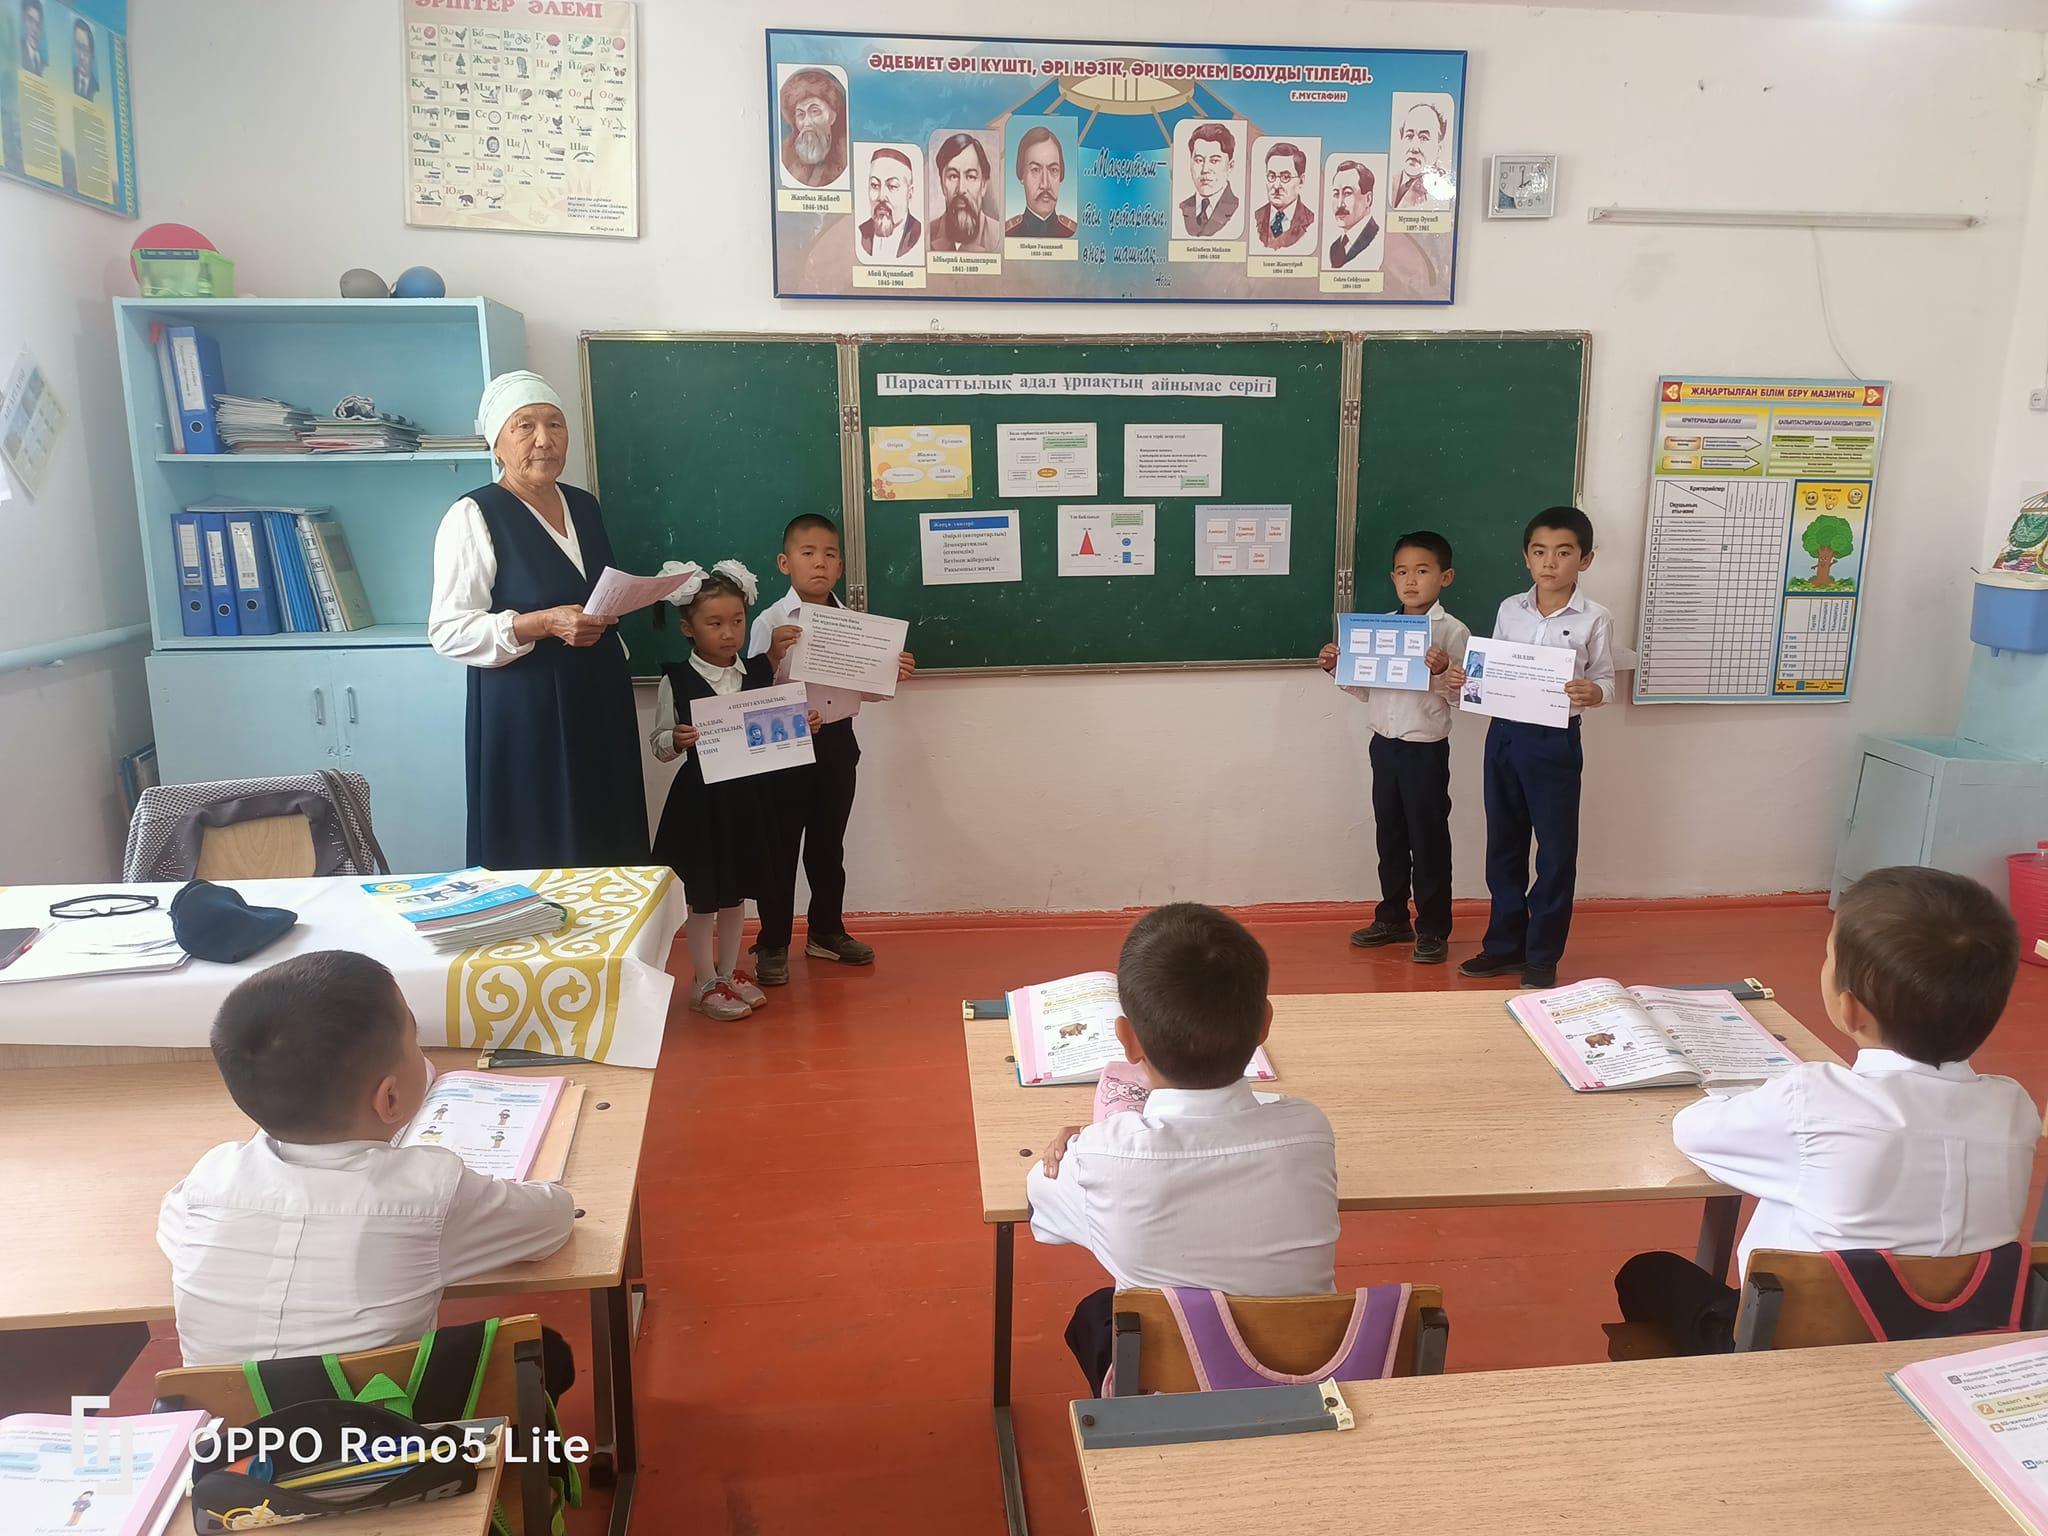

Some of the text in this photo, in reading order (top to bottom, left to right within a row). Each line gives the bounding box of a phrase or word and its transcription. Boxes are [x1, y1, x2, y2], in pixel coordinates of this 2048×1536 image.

[528, 0, 603, 18] ӘЛЕМІ
[869, 55, 1372, 84] ӘДЕБИЕТ ӘРІ КҮШТІ, ӘРІ НӘЗІК, ӘРІ КӨРКЕМ БОЛУДЫ ТІЛЕЙДІ.
[886, 375, 1271, 395] Парасаттылық адал ұрпақтың айнымас серігі
[1691, 387, 1855, 398] ЖАҢАРТЫЛҒАН БІЛІМ БЕРУ МАЗМҰНЫ
